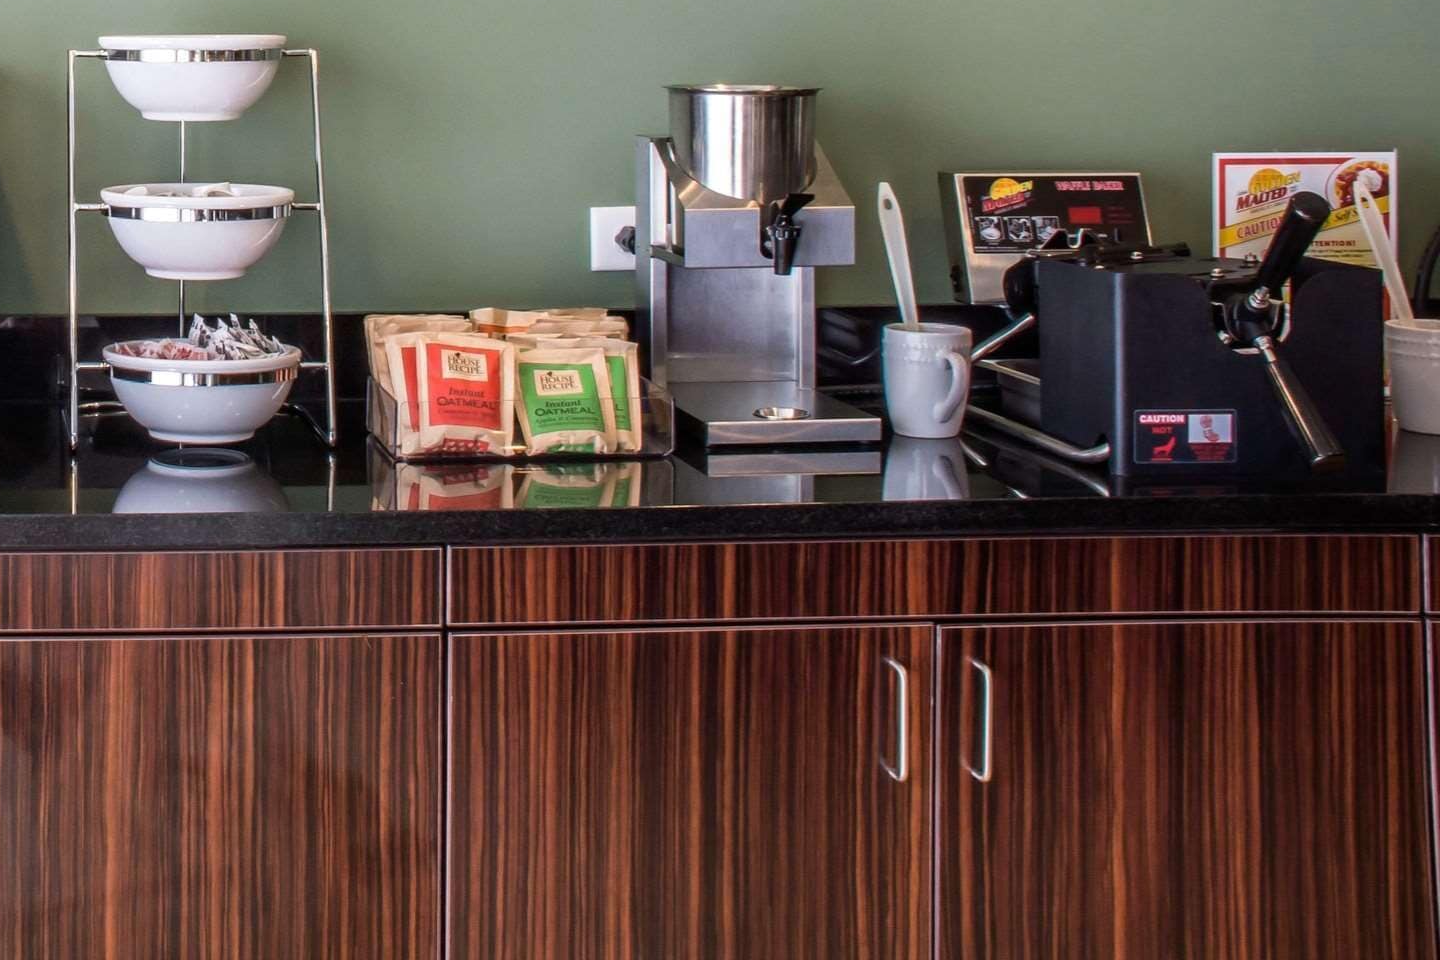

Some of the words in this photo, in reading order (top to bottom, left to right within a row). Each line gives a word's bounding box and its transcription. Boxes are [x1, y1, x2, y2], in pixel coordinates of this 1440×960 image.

[1236, 186, 1287, 210] MALTED
[448, 355, 480, 366] HOUSE
[448, 364, 481, 374] RECIPE
[540, 374, 575, 384] HOUSE
[542, 382, 576, 391] RECIPE
[448, 387, 484, 398] Instant
[436, 396, 499, 410] OATMEAL
[545, 400, 582, 408] Instant
[534, 406, 596, 417] OATMEAL
[1139, 414, 1185, 423] CAUTION
